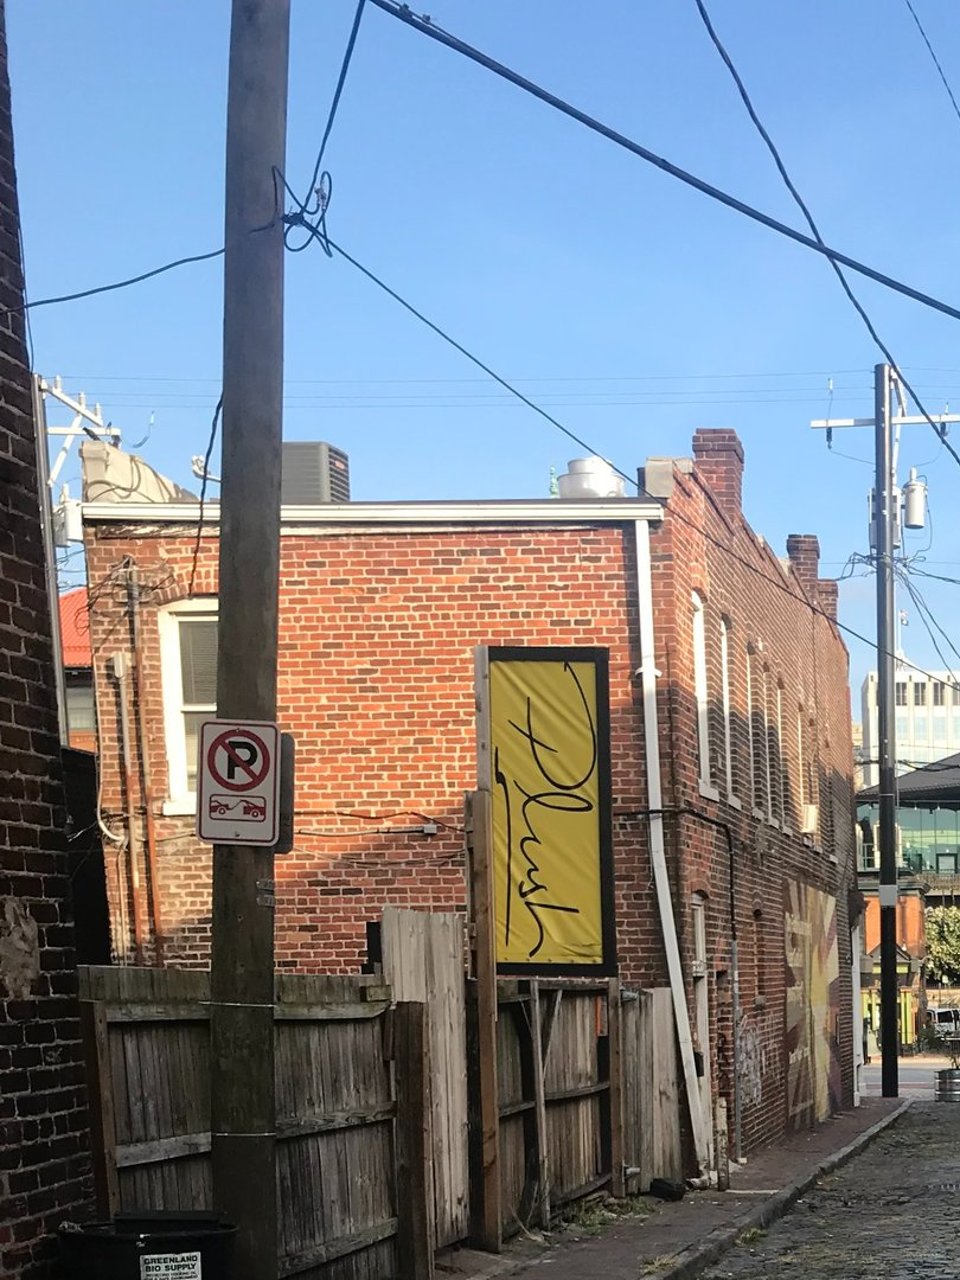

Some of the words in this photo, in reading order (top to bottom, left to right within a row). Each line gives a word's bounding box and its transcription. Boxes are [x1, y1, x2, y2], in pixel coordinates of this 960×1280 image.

[144, 1255, 198, 1265] GREENLAND
[145, 1265, 161, 1273] BIO
[164, 1263, 197, 1272] SUPPLY
